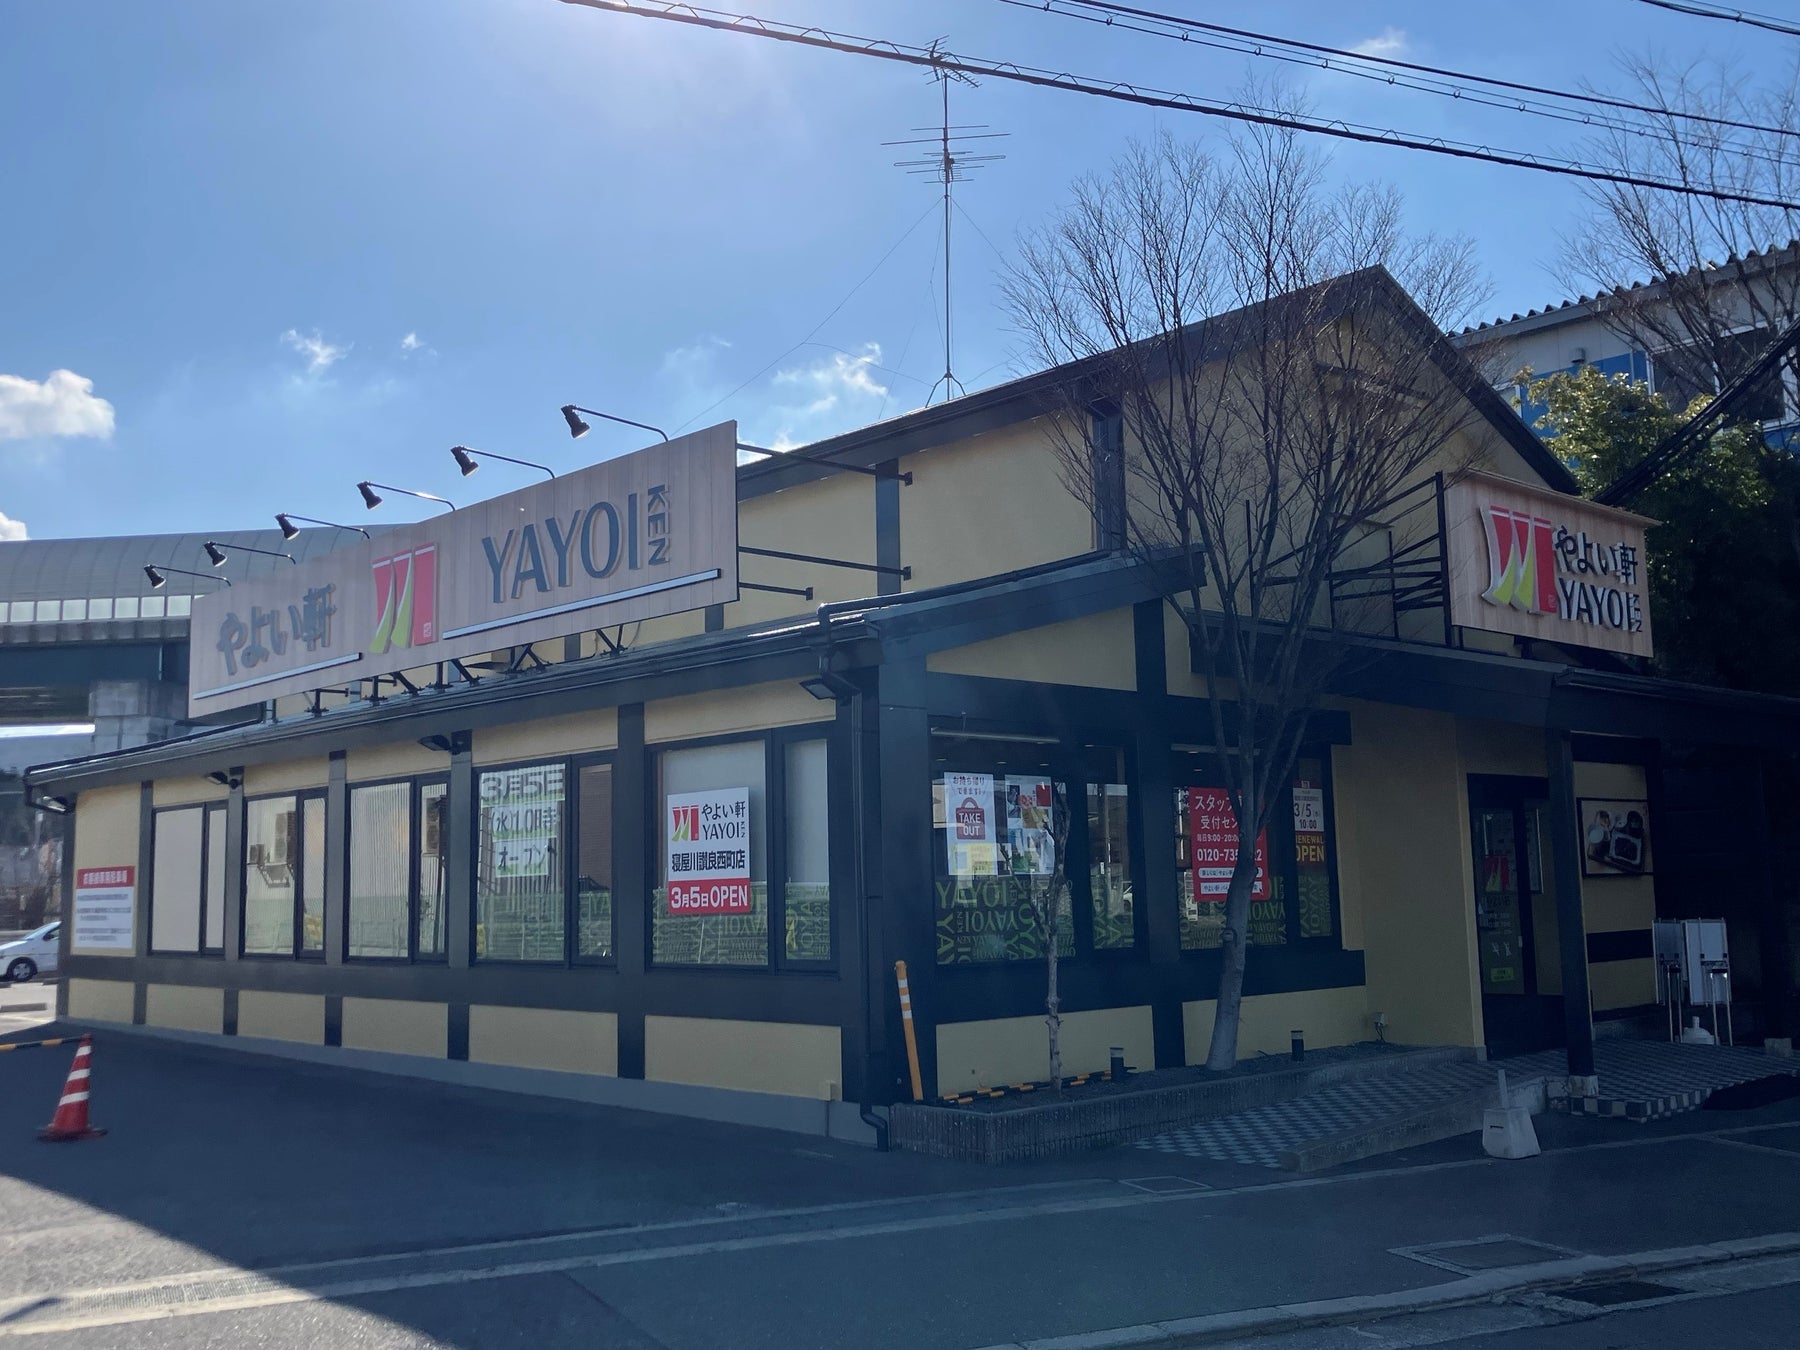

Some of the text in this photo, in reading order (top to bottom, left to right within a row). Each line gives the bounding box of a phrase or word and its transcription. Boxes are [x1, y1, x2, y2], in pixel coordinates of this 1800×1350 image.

[647, 484, 672, 566] KEN
[482, 492, 640, 604] YAYOI
[1552, 525, 1638, 585] やよい軒
[1558, 577, 1632, 630] YAYOI
[1629, 592, 1643, 633] KEN
[217, 583, 336, 676] やよい軒
[482, 767, 564, 802] 3月5日
[702, 801, 746, 822] やよい軒
[959, 812, 981, 824] TAKE
[1299, 819, 1317, 830] 10:00
[702, 821, 740, 841] YAYOI
[963, 825, 980, 836] OUT
[498, 844, 547, 870] オープン
